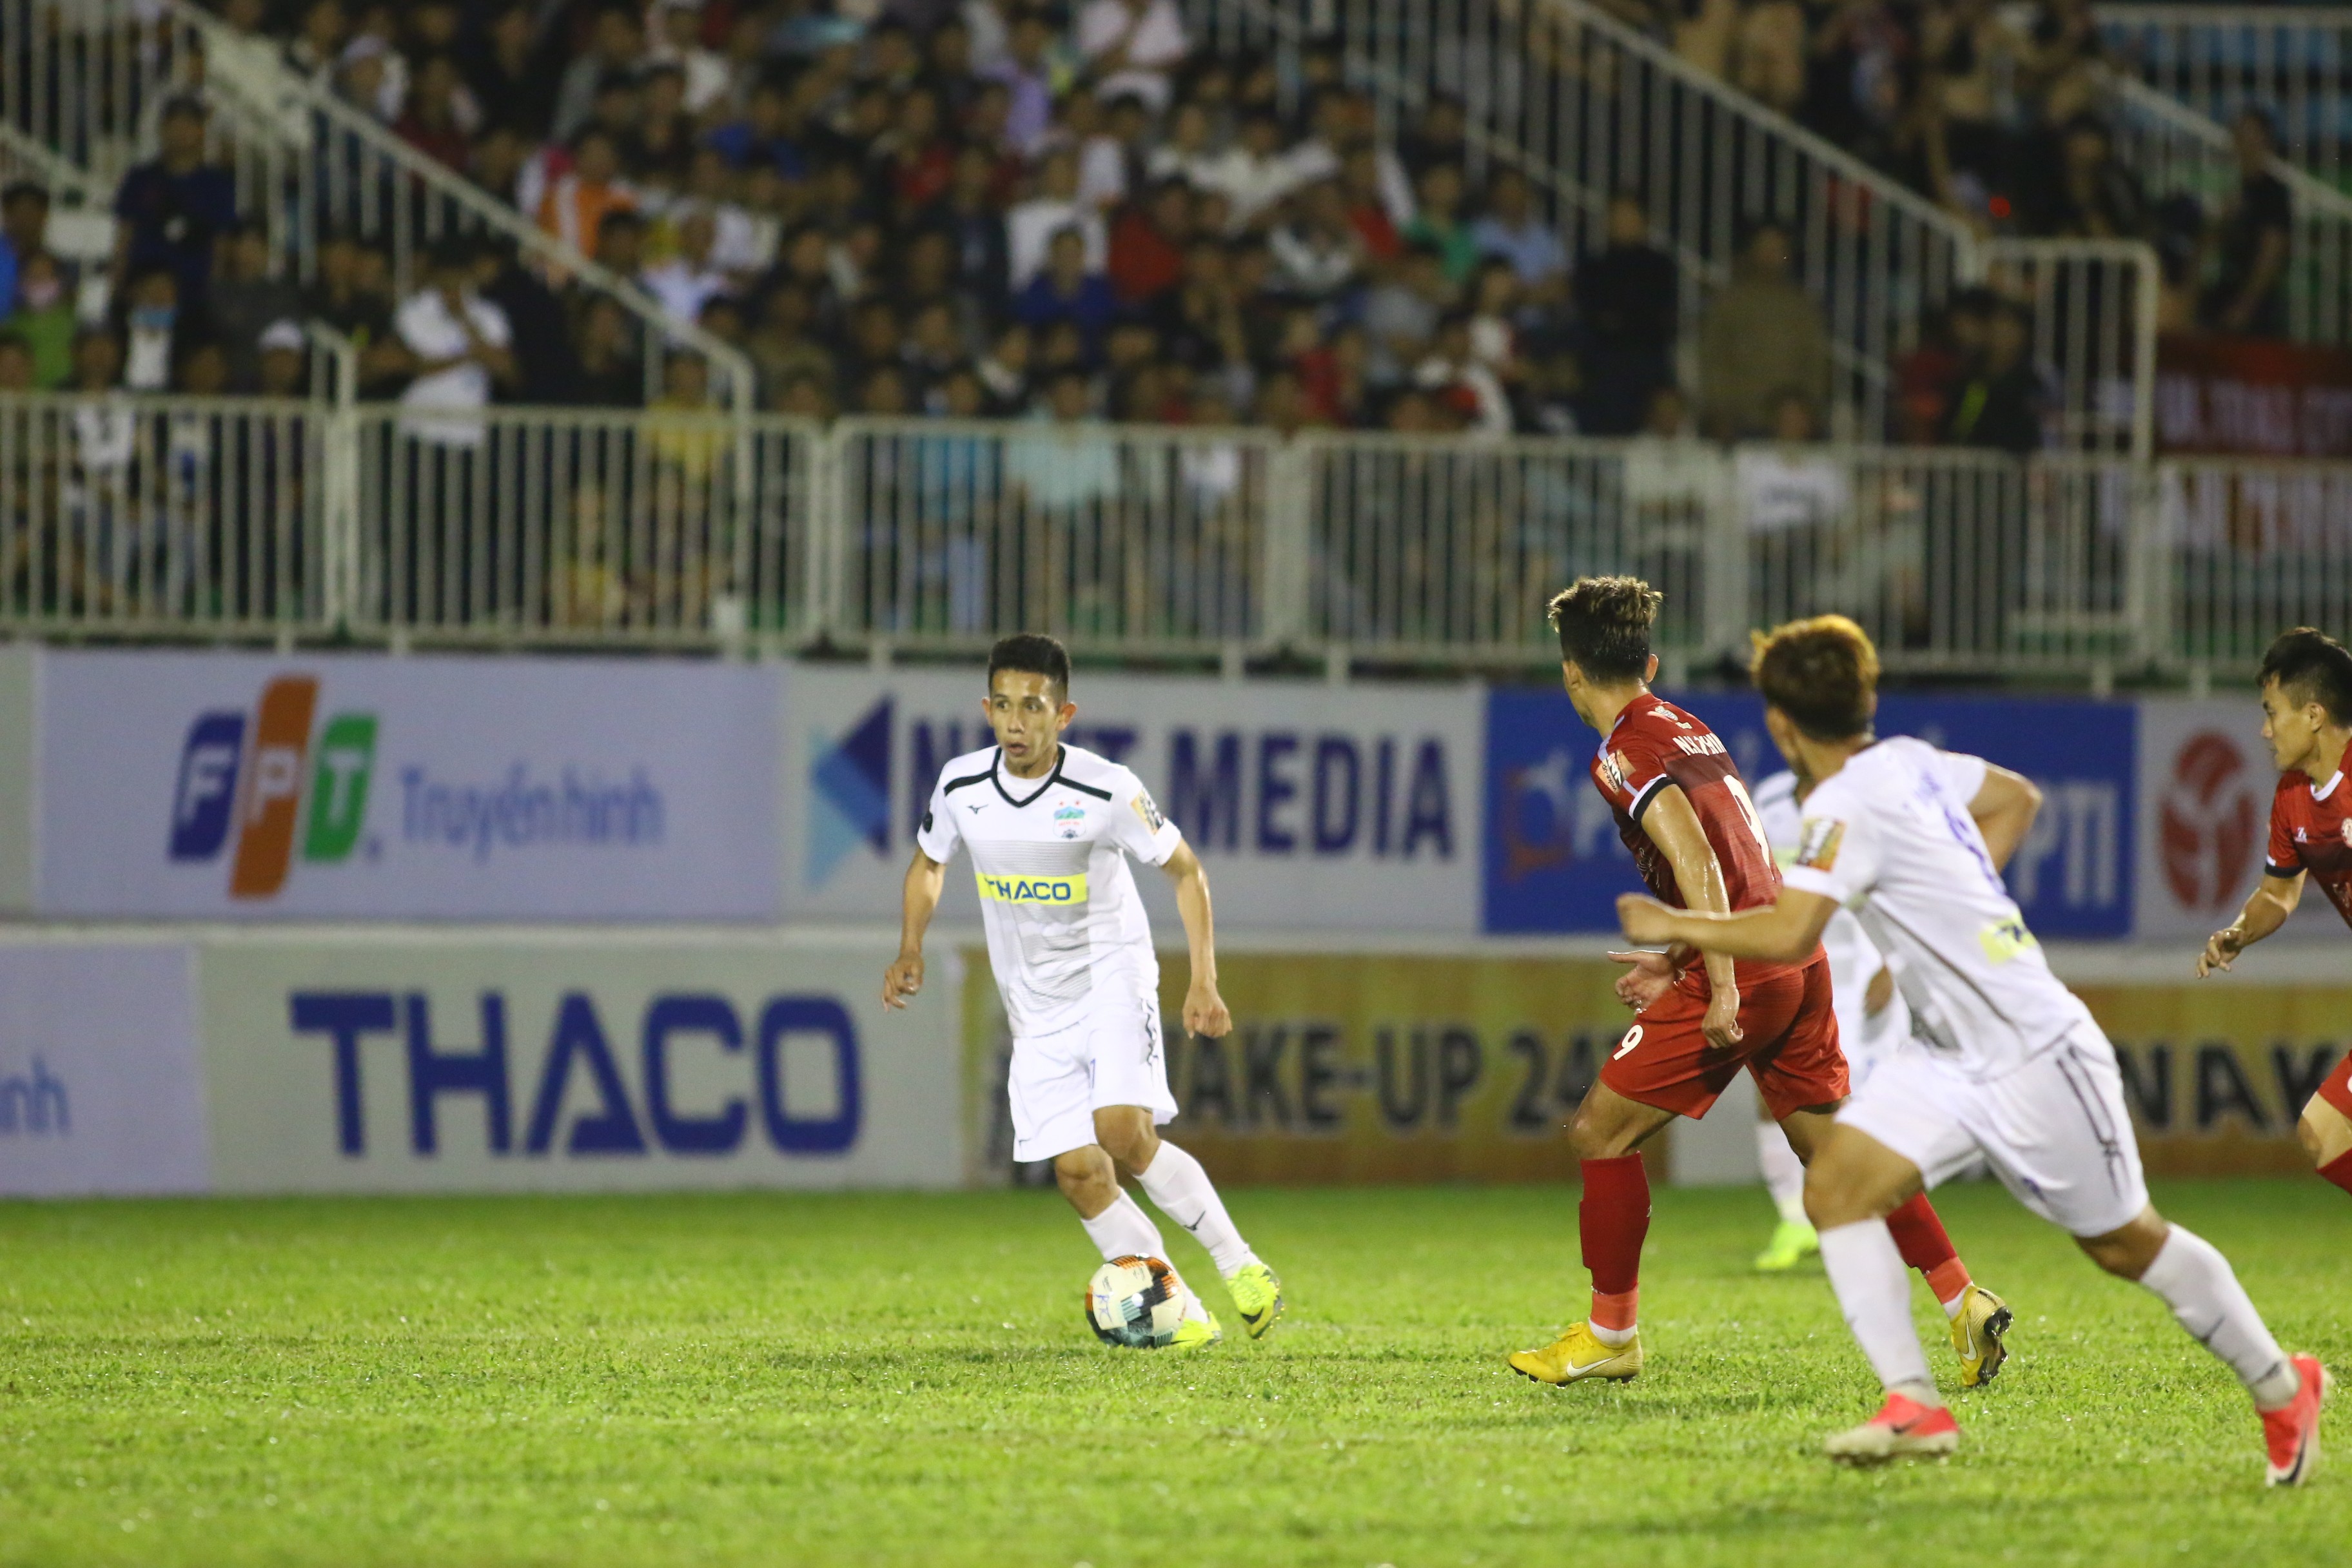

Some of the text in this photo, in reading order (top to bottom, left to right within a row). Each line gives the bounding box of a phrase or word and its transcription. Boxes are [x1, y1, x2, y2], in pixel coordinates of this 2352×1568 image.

[1168, 725, 1453, 861] MEDIA
[1723, 774, 1776, 881] 9
[288, 989, 864, 1158] THACO
[1161, 1024, 1480, 1132] AKE-UP
[1612, 1024, 1643, 1061] 9
